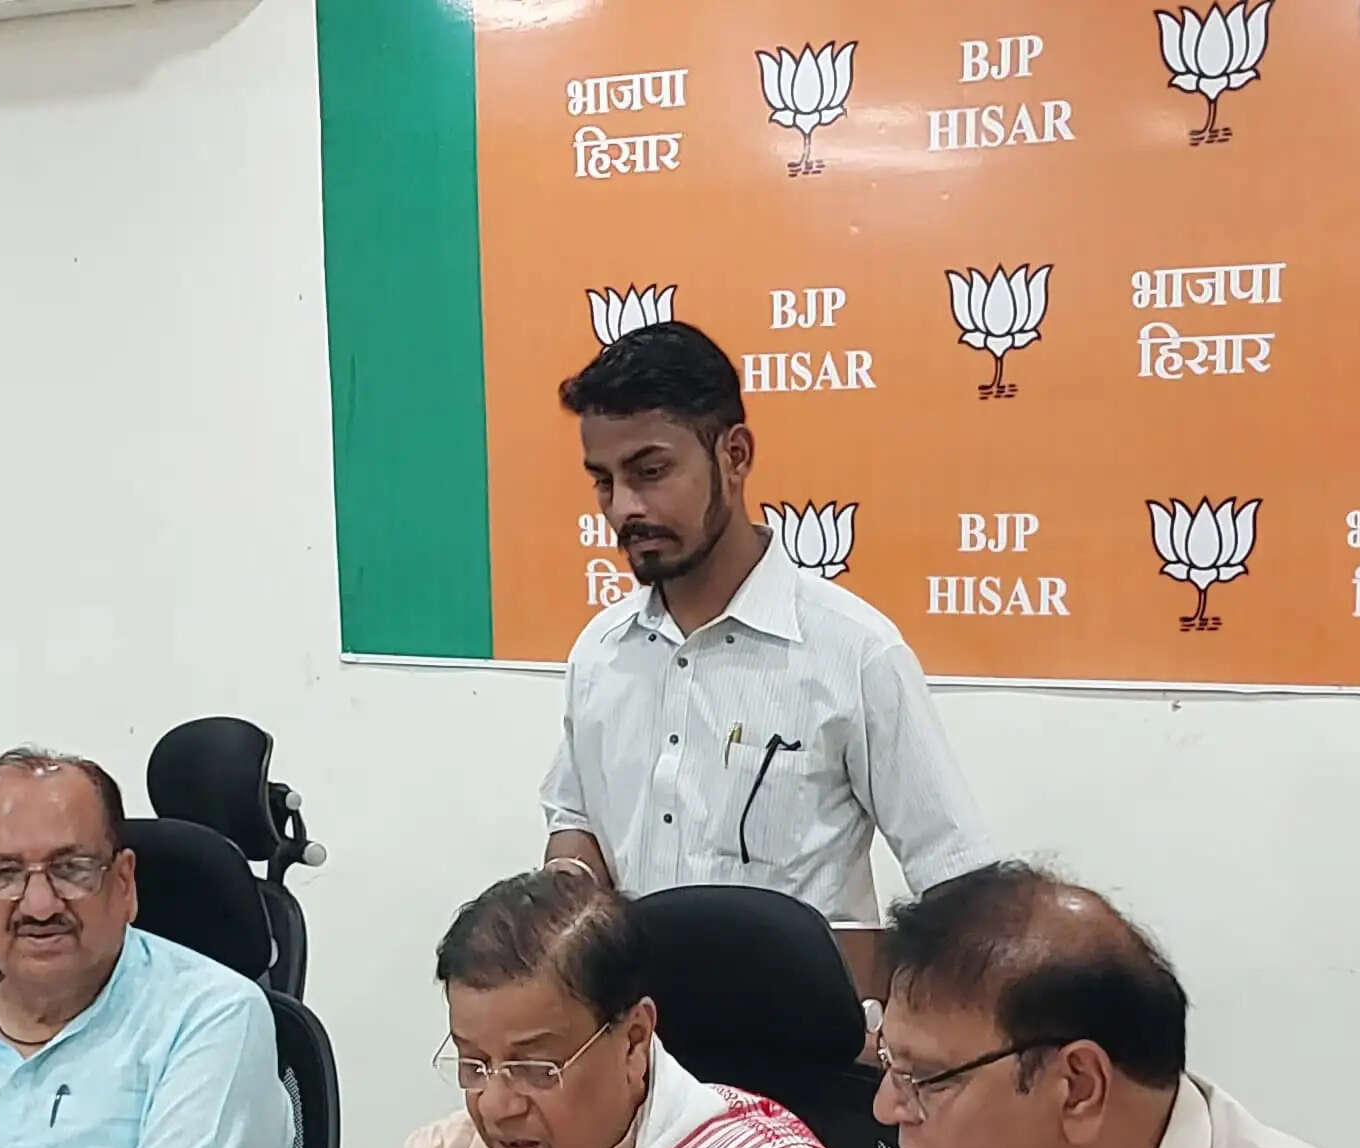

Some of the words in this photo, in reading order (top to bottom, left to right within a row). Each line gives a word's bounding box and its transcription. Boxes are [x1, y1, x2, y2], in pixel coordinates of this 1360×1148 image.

[960, 35, 1044, 82] BJP
[567, 69, 689, 112] भाजपा
[927, 100, 1075, 152] HISAR
[573, 127, 682, 178] हिसार
[770, 287, 847, 329] BJP
[1130, 263, 1286, 309] भाजपा
[742, 350, 877, 393] HISAR
[1137, 323, 1275, 379] हिसार
[959, 513, 1040, 553] BJP
[927, 576, 1070, 616] HISAR
